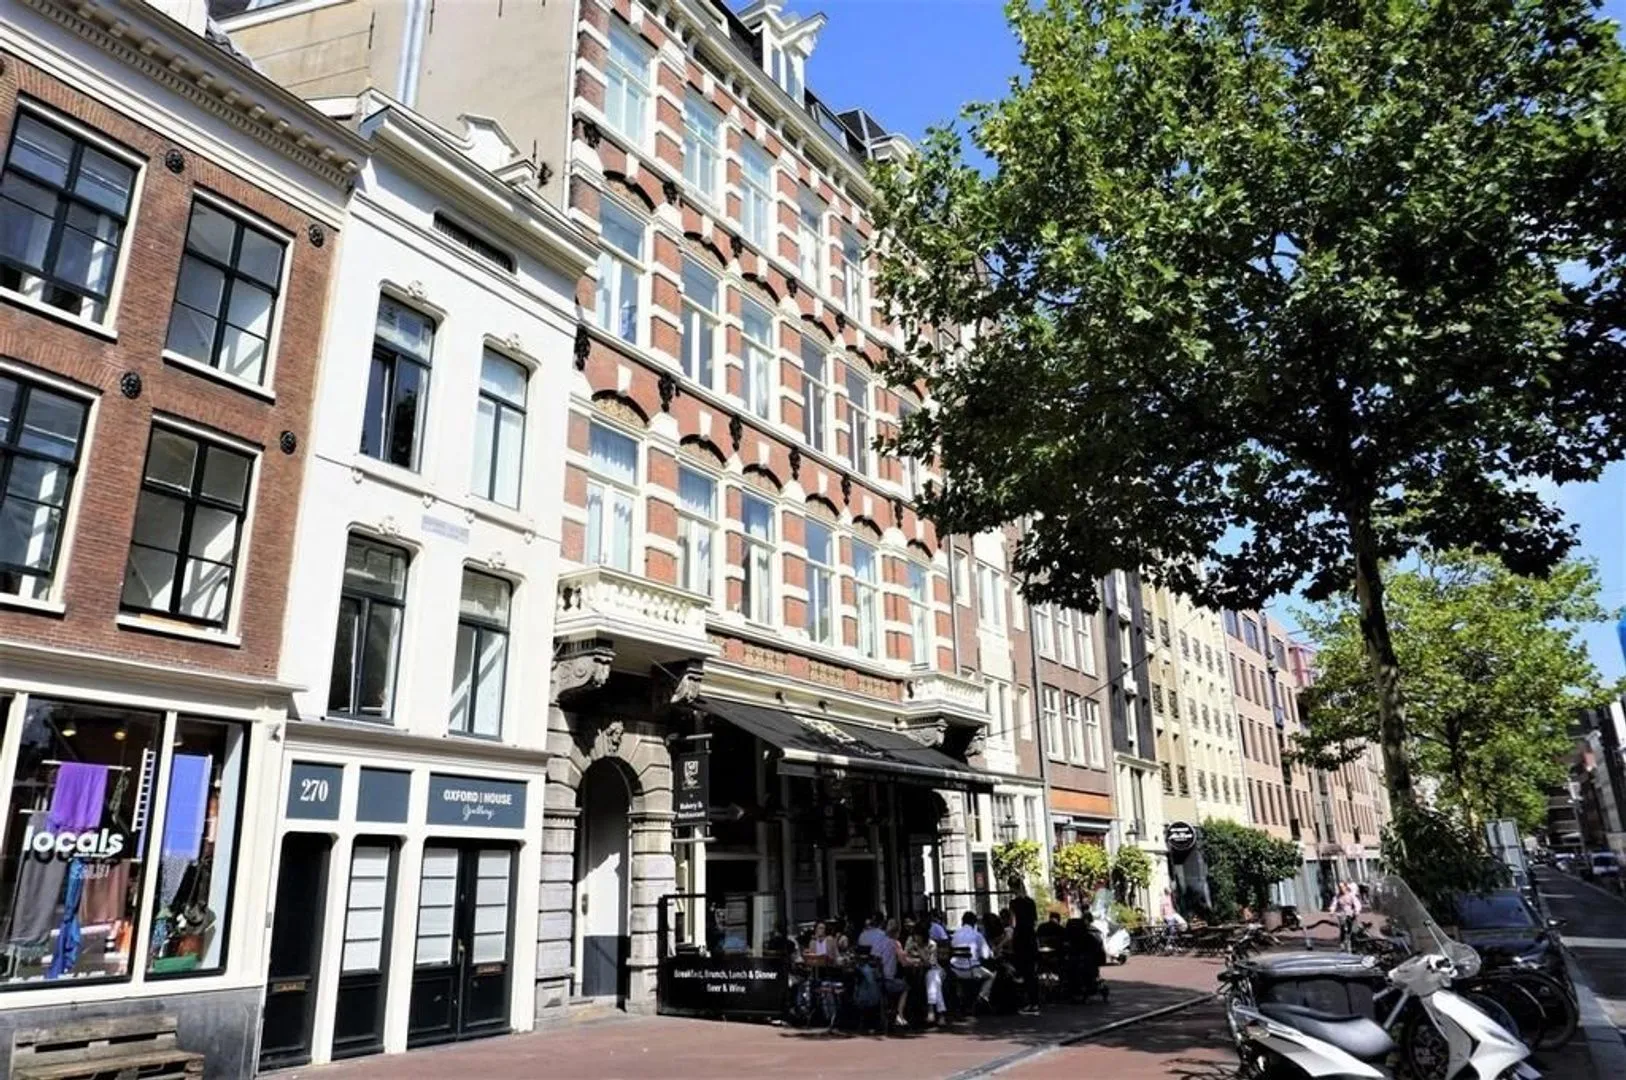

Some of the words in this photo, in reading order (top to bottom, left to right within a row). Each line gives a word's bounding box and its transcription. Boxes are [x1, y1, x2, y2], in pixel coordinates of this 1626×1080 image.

[300, 778, 329, 802] 270
[443, 788, 478, 803] OXFORD
[484, 792, 513, 805] HOUSE
[23, 825, 124, 858] locals
[729, 969, 747, 979] Lunch
[748, 970, 754, 979] &
[755, 969, 777, 979] Dinner
[707, 983, 721, 992] Beer
[729, 983, 745, 993] Wine
